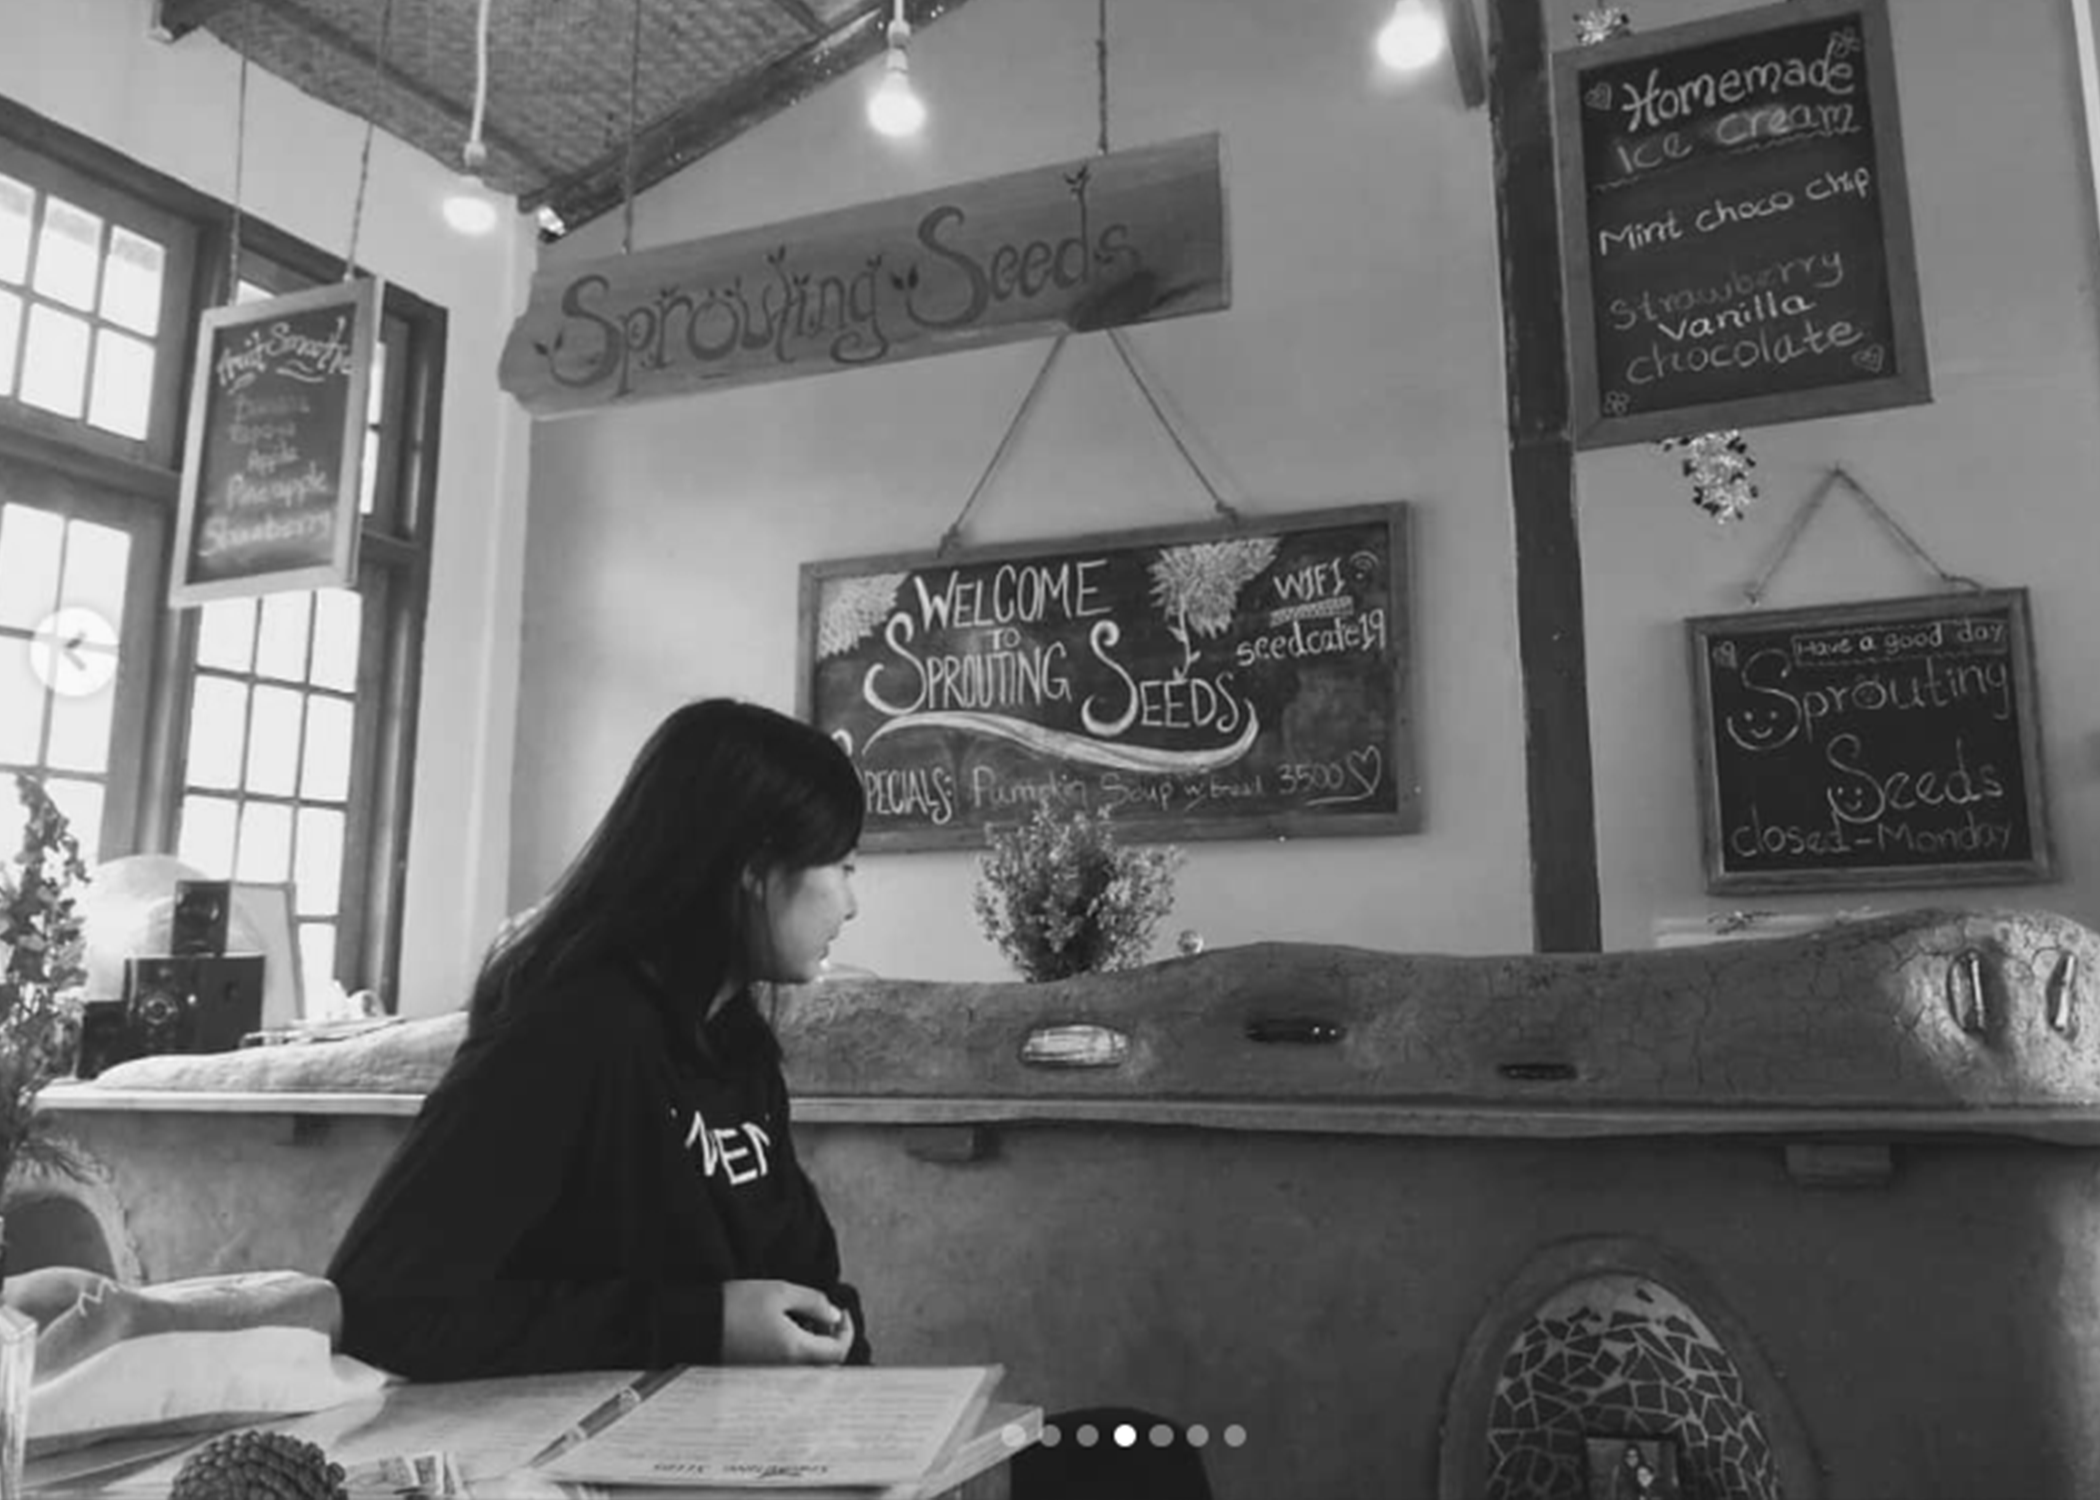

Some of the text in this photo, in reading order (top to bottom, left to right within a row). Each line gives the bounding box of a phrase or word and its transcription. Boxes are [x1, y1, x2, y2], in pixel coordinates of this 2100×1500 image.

[1622, 38, 1857, 131] Homemade
[1617, 133, 1693, 174] Ice
[1600, 166, 1871, 256] Mint choco chip
[549, 164, 1142, 396] Sprouting Seeds
[914, 560, 1114, 632] WELCOME
[992, 627, 1020, 651] TO
[1798, 618, 2004, 657] Have a good day
[863, 611, 1237, 737] SPROUTING SEEDS
[1727, 647, 2010, 751] Sprouting
[1277, 762, 1345, 796] 3500
[1826, 733, 2004, 824] Seeds
